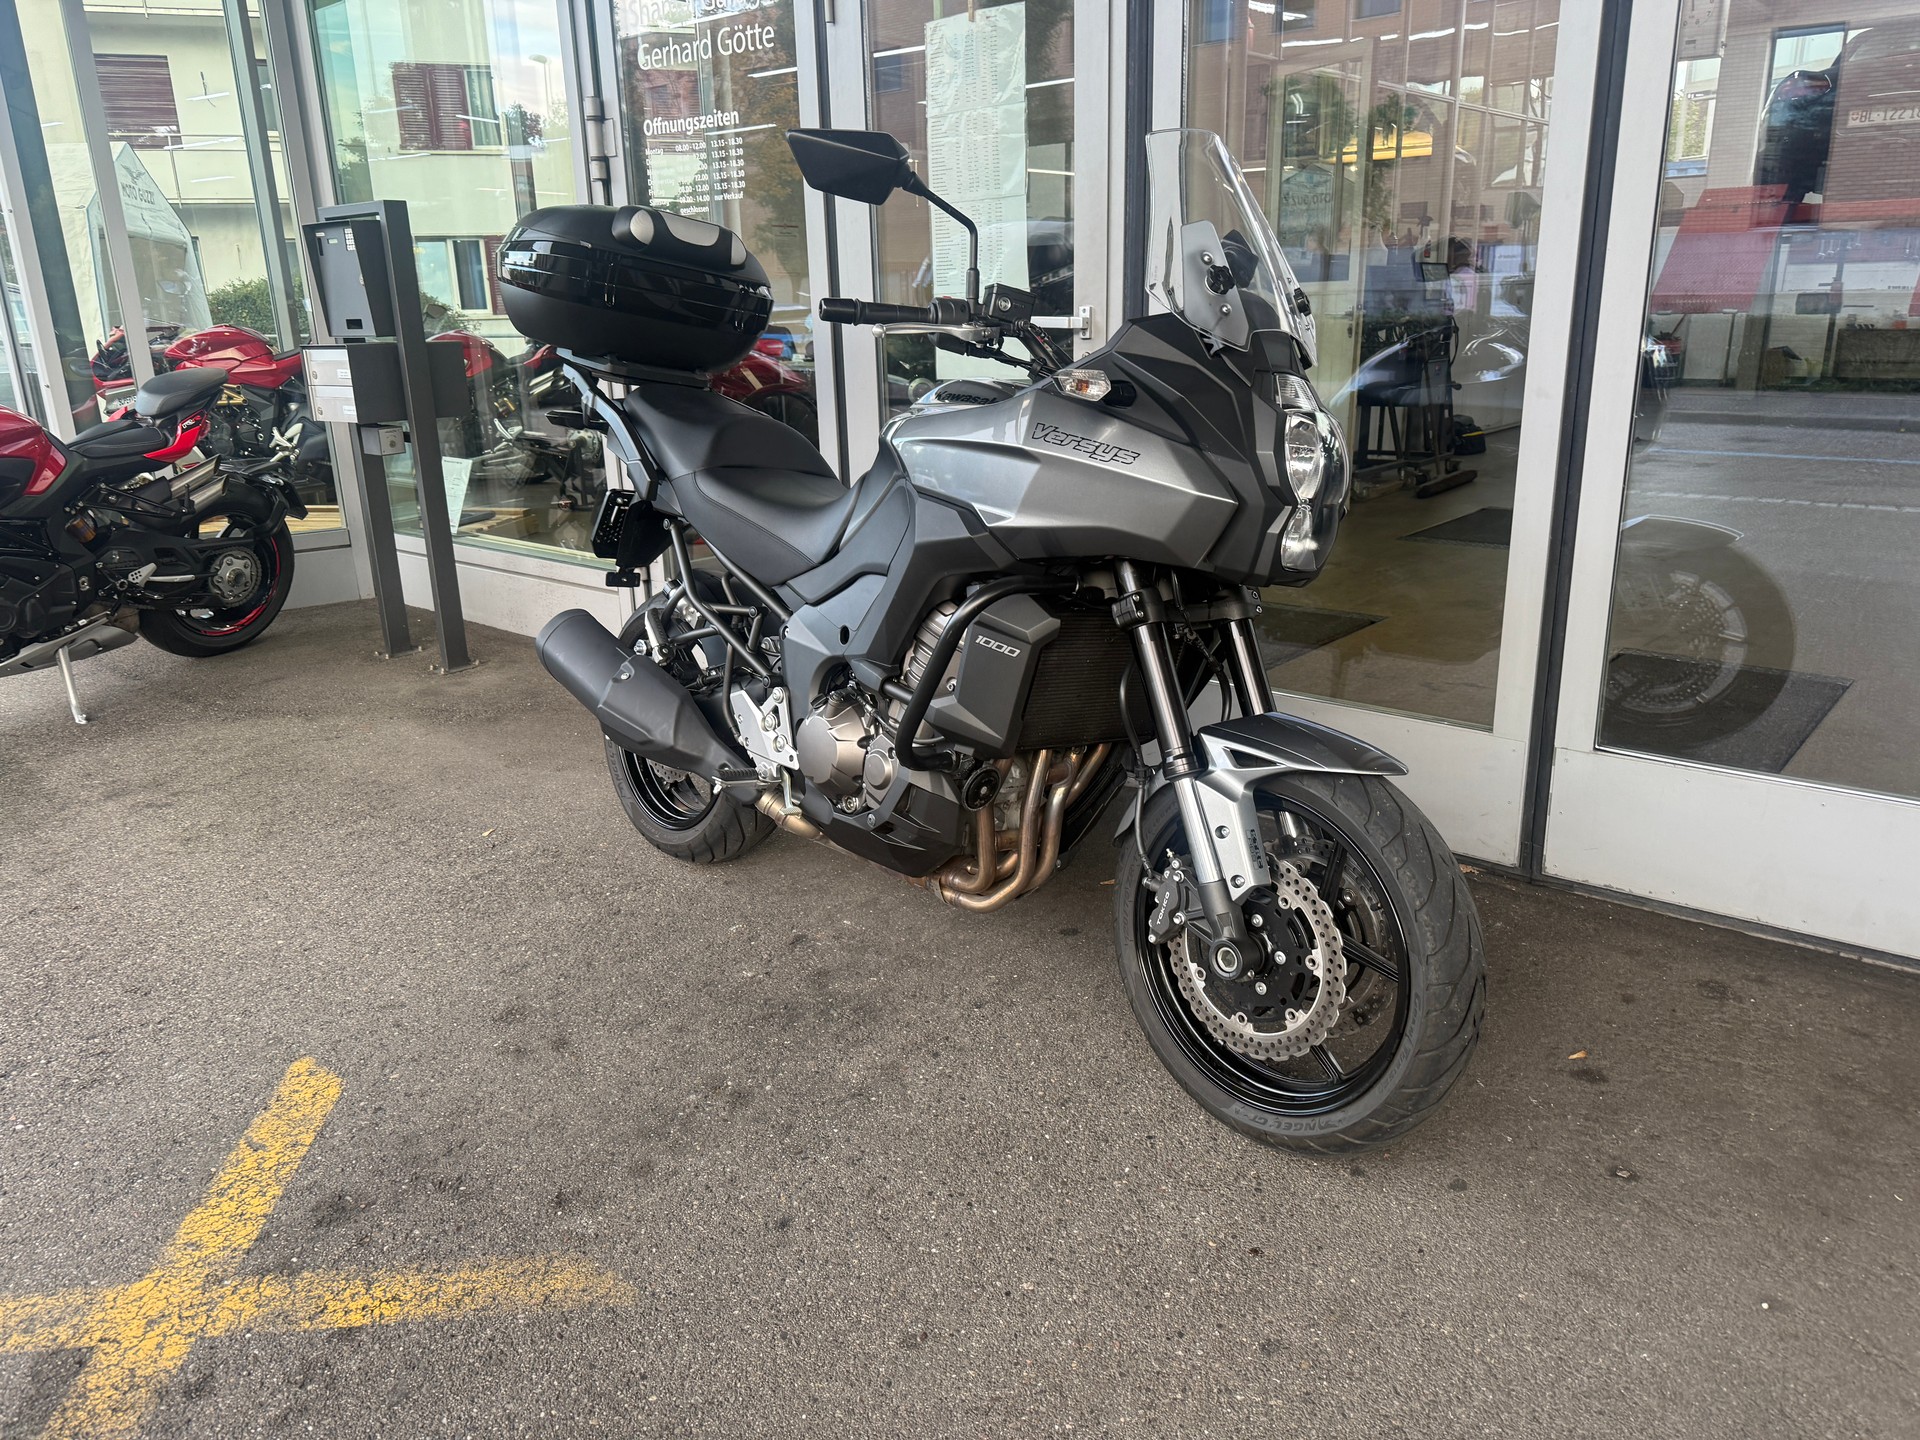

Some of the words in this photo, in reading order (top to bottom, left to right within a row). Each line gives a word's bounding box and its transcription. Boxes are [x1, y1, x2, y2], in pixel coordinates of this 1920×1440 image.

[637, 28, 713, 71] Gerhard
[717, 22, 775, 56] Götte
[723, 191, 744, 200] Verkauf
[1032, 422, 1141, 465] Versys
[975, 635, 1021, 658] 1000
[1156, 891, 1170, 925] TOKICO
